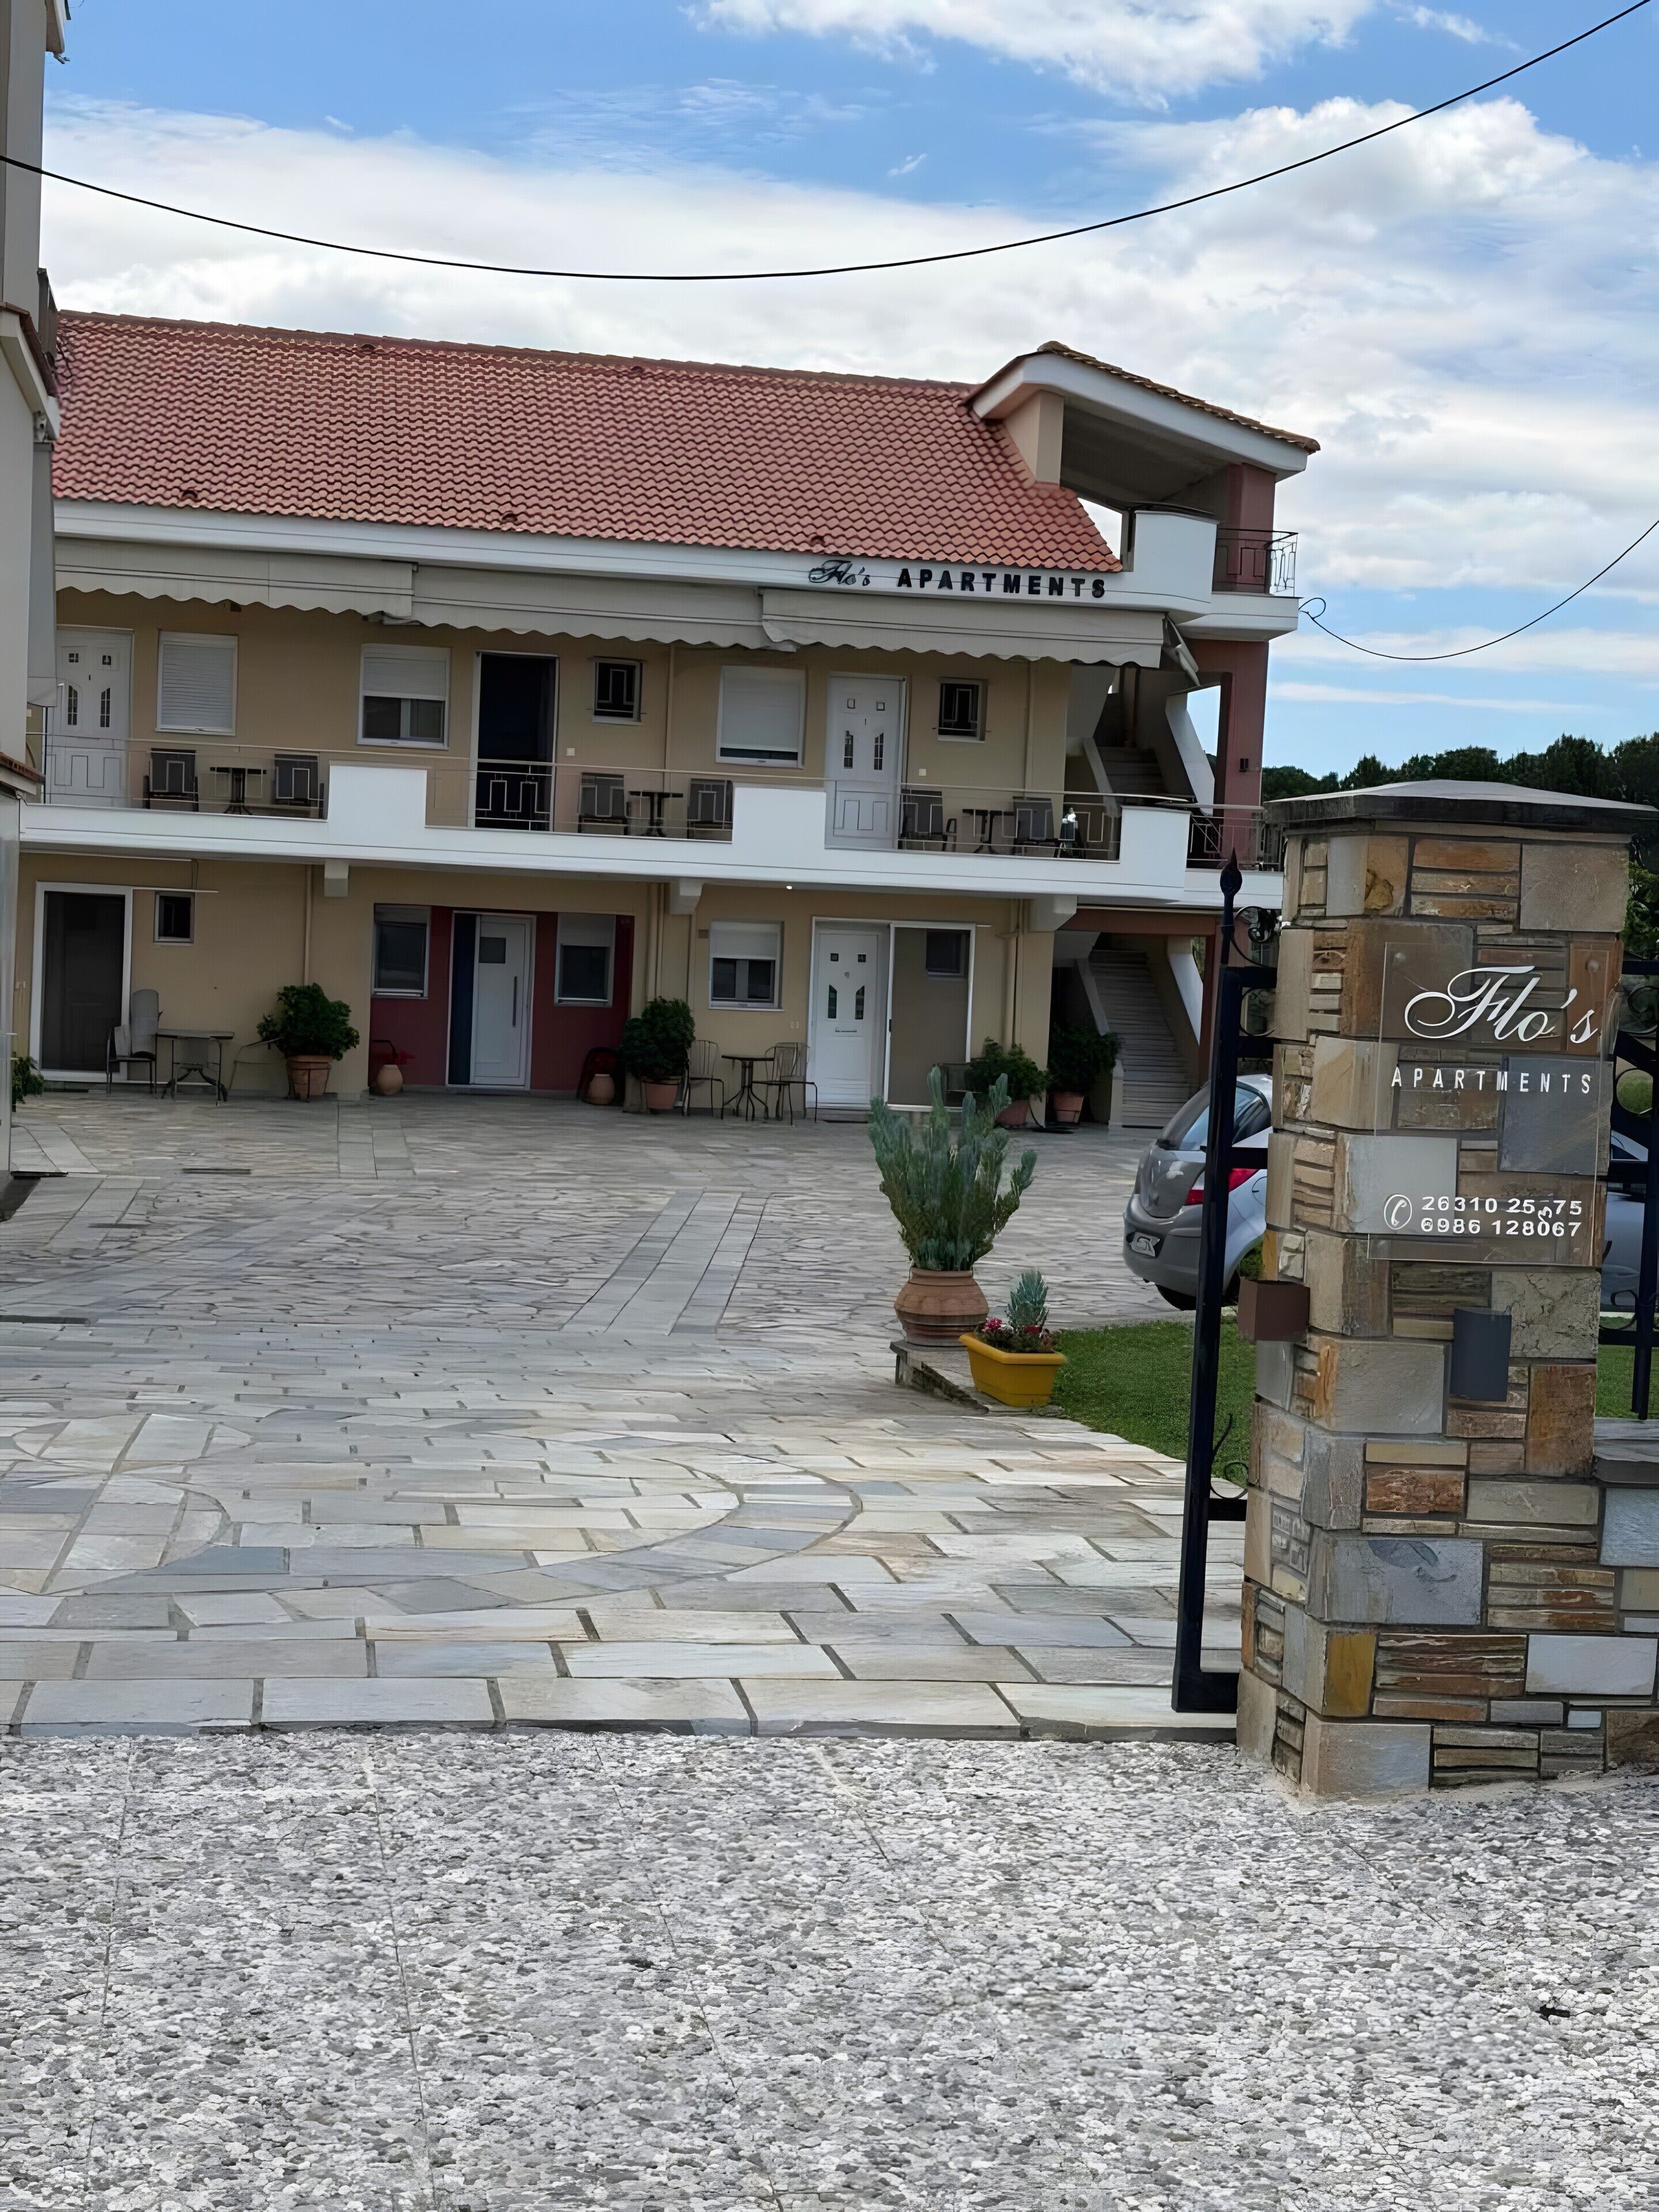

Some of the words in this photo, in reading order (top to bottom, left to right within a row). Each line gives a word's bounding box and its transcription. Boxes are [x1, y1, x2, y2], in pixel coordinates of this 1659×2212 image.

[897, 569, 1105, 598] APARTMENTS
[1404, 965, 1598, 1043] Flo's
[1391, 1066, 1591, 1093] APARTMENTS
[1422, 1196, 1498, 1213] 26310
[1421, 1218, 1480, 1234] 6986
[1491, 1220, 1582, 1237] 128067
